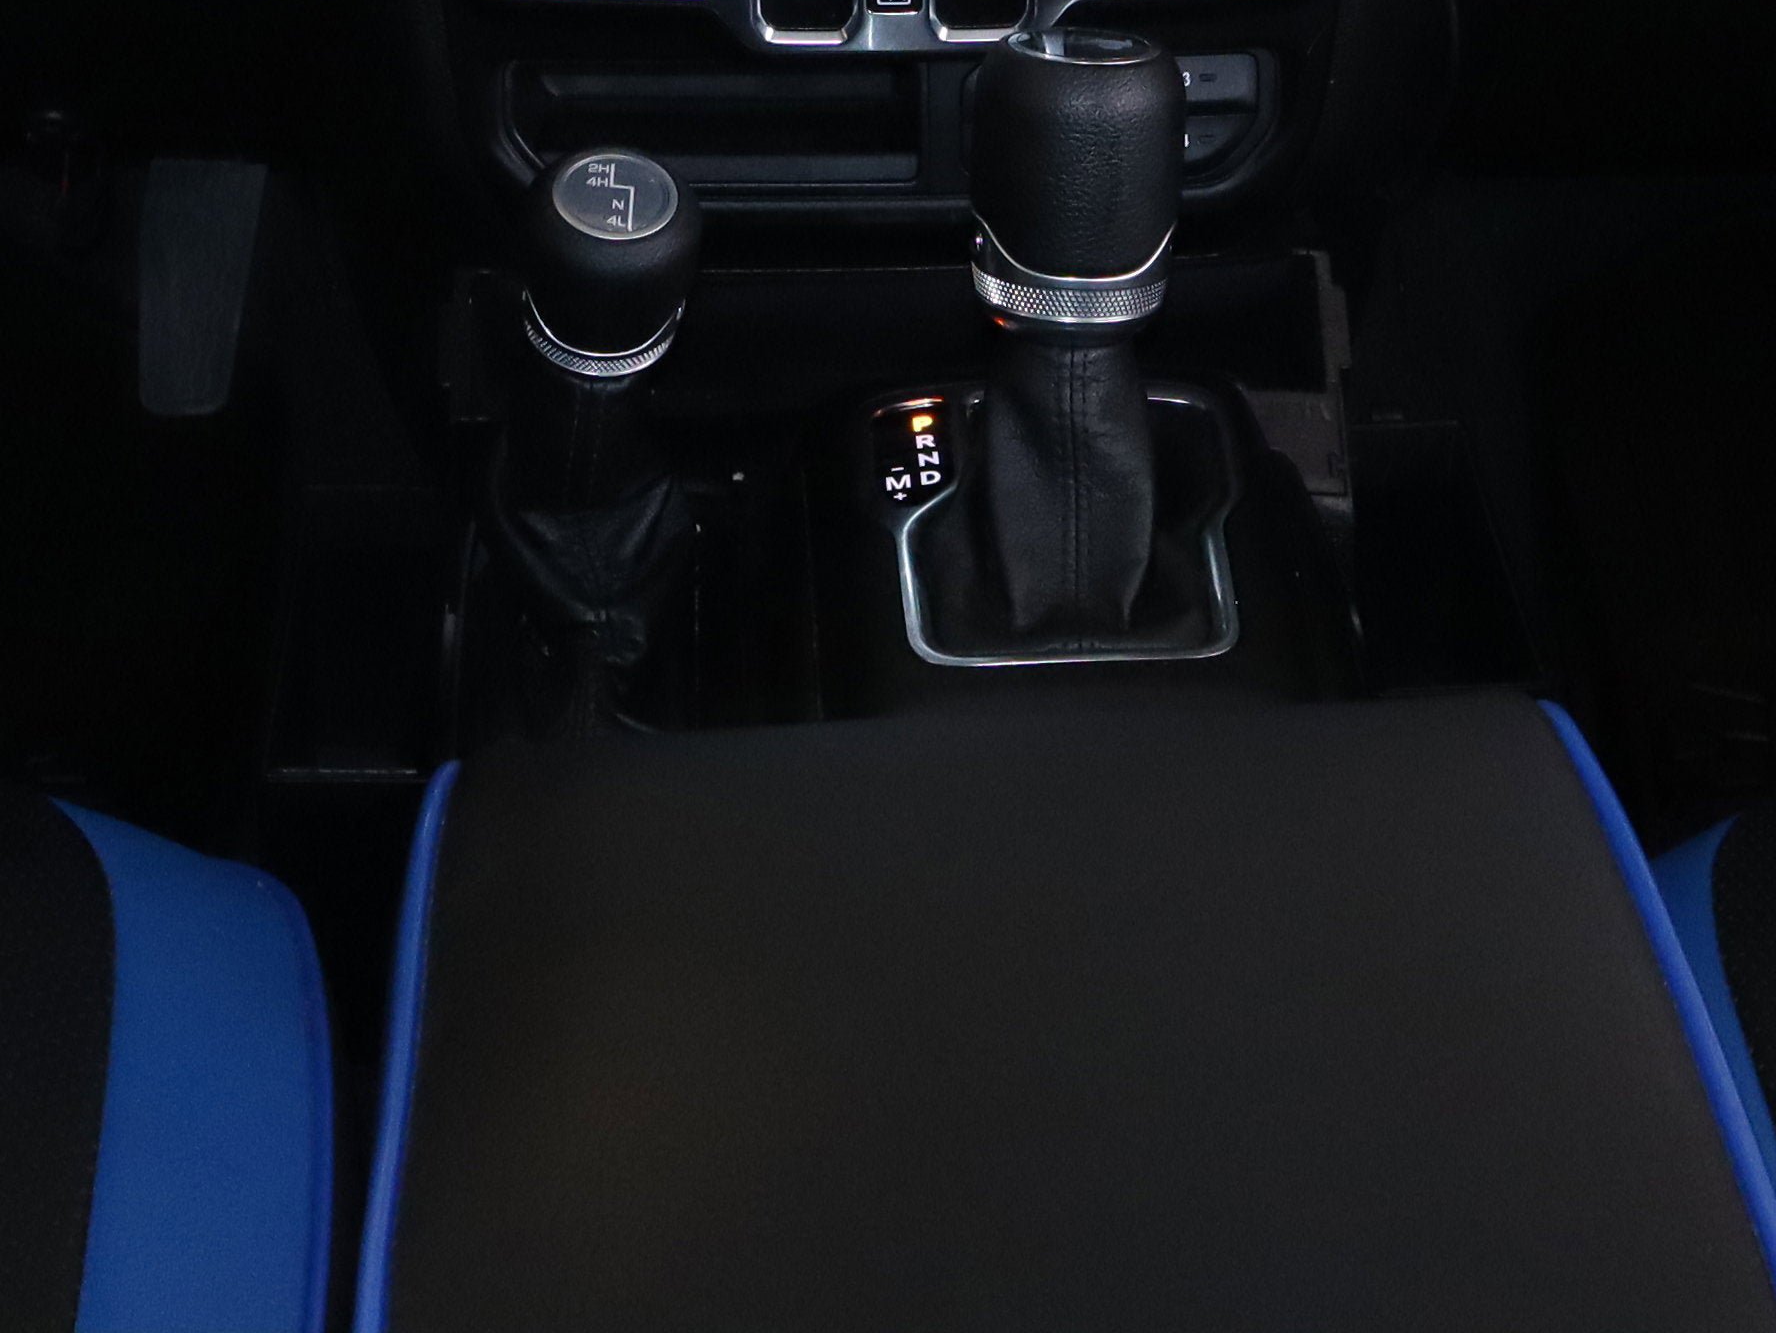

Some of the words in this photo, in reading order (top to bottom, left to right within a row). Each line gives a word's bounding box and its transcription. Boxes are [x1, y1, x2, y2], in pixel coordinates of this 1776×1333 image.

[587, 163, 610, 174] 2H
[586, 177, 609, 187] 4H
[612, 198, 624, 211] N
[606, 215, 626, 227] 4L
[912, 415, 933, 432] P
[915, 434, 935, 448] R
[918, 451, 940, 467] N
[920, 470, 942, 486] D
